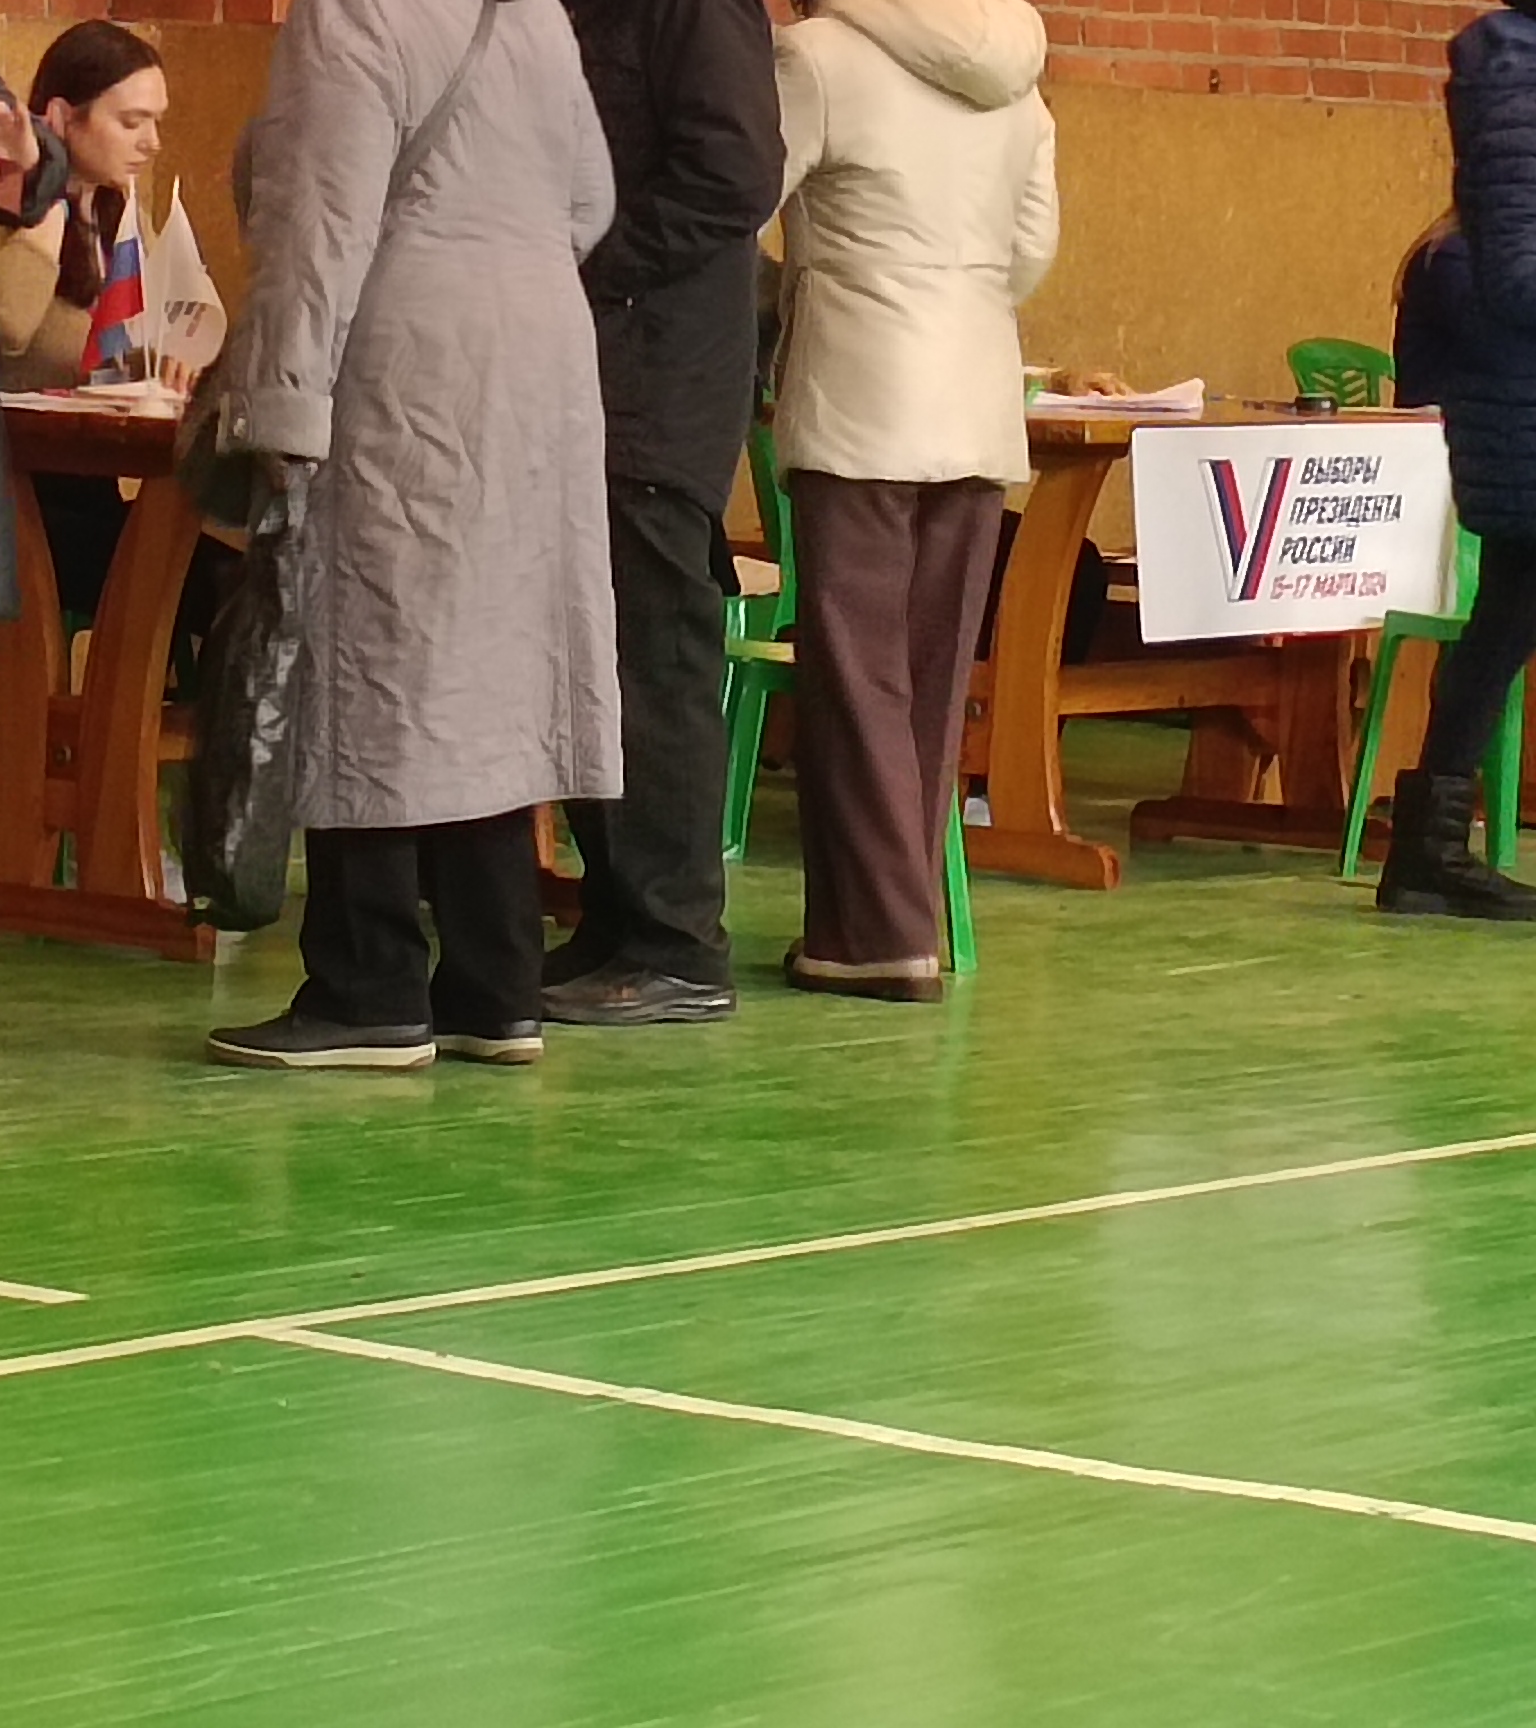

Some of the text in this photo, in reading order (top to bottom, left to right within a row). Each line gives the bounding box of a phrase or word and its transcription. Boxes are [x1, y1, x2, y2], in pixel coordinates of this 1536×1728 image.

[1299, 455, 1383, 486] ВЫБОРЫ
[1288, 493, 1403, 528] ПРЕЗИДЕНТА
[1277, 534, 1358, 565] РОССИИ
